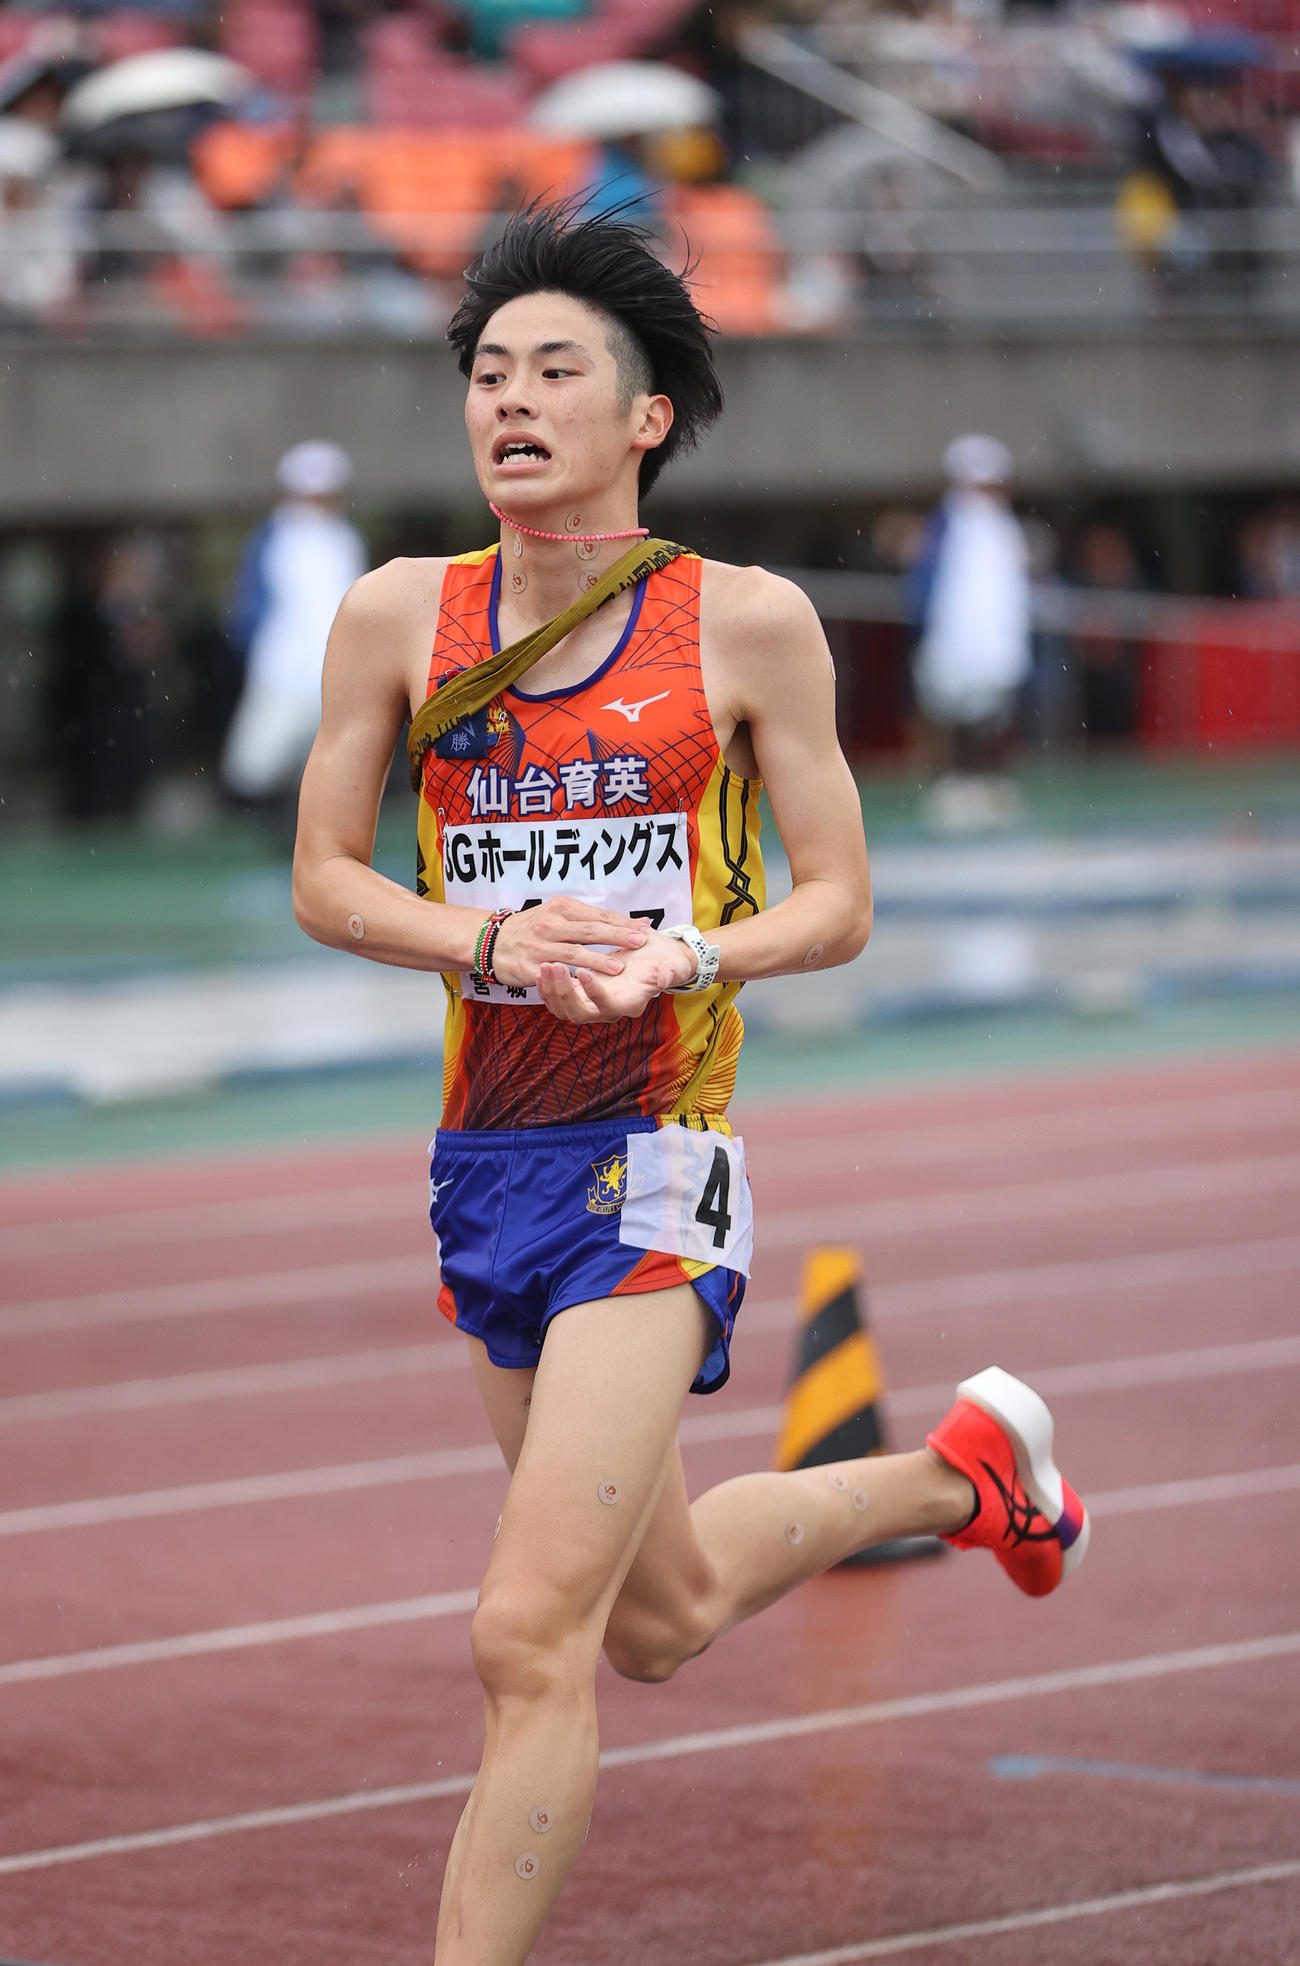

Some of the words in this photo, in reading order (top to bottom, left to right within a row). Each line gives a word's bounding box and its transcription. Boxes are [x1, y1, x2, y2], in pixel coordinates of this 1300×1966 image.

[466, 756, 651, 816] 仙台育英
[695, 1146, 732, 1249] 4
